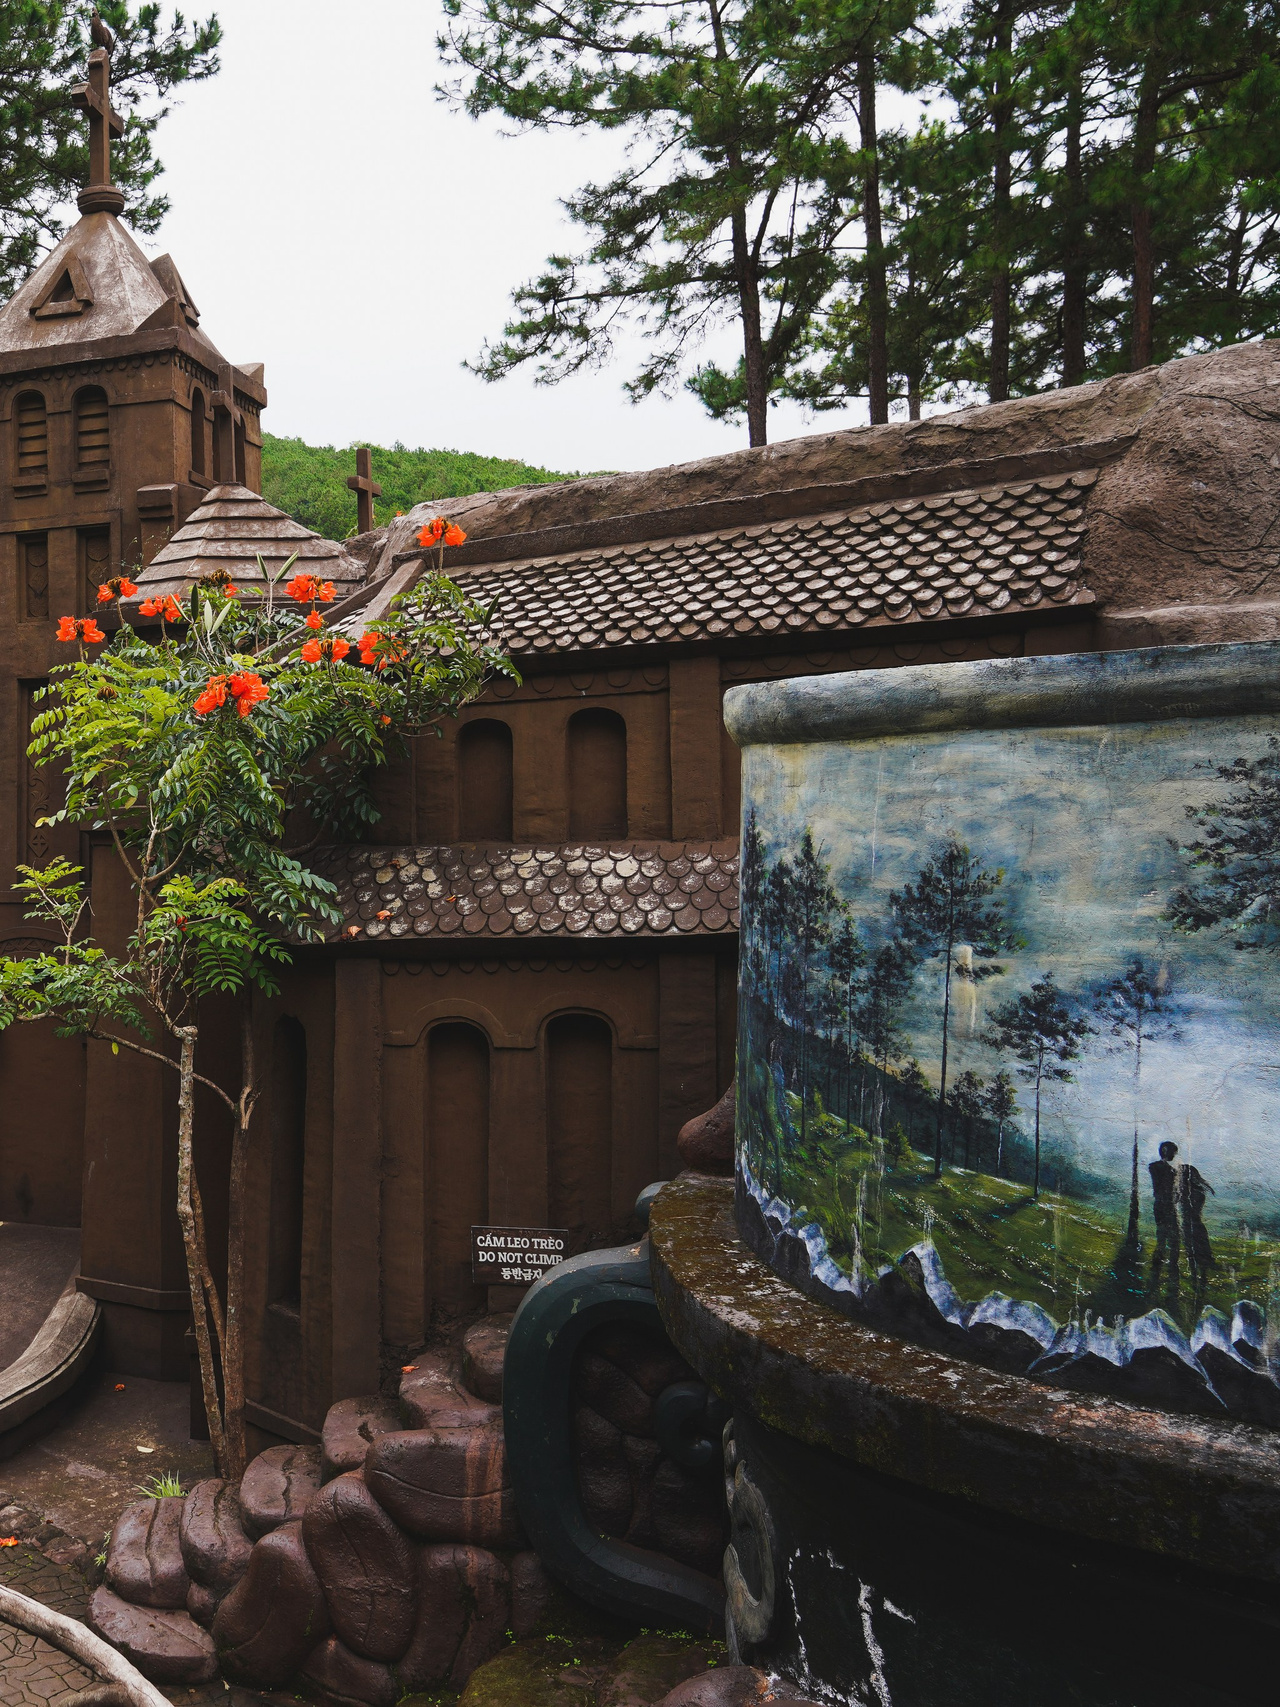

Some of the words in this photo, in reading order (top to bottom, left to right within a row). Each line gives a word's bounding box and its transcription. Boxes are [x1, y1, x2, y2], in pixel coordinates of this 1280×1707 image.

[477, 1233, 505, 1247] CẤM
[507, 1237, 530, 1248] LEO
[531, 1237, 564, 1250] TRÈO
[478, 1251, 495, 1262] DO
[498, 1252, 523, 1263] NOT
[525, 1253, 563, 1264] CLIMB
